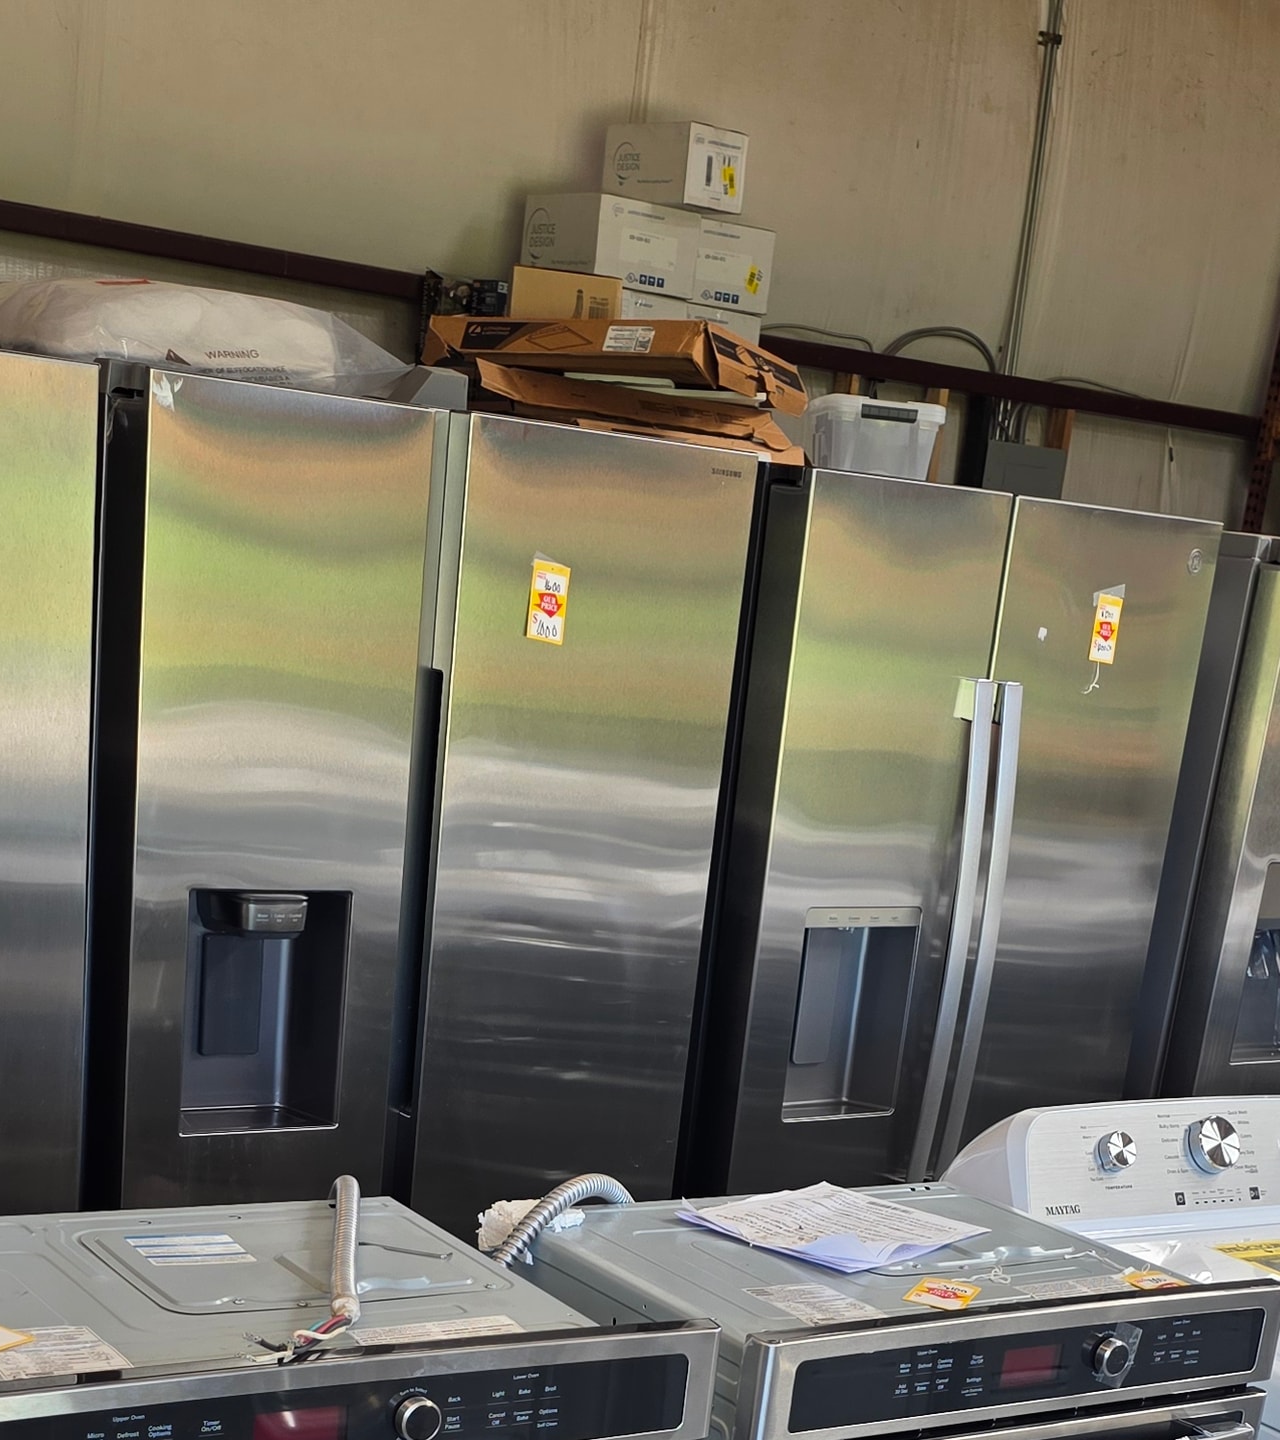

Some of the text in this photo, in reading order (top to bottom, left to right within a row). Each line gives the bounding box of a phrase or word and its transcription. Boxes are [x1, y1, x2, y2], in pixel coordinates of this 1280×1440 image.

[618, 153, 640, 161] JUSTICE
[617, 163, 640, 171] DESIGN
[531, 224, 556, 235] JUSTICE
[529, 236, 554, 247] DESIGN
[1046, 1204, 1081, 1216] MAYTAG
[492, 1390, 505, 1398] Light
